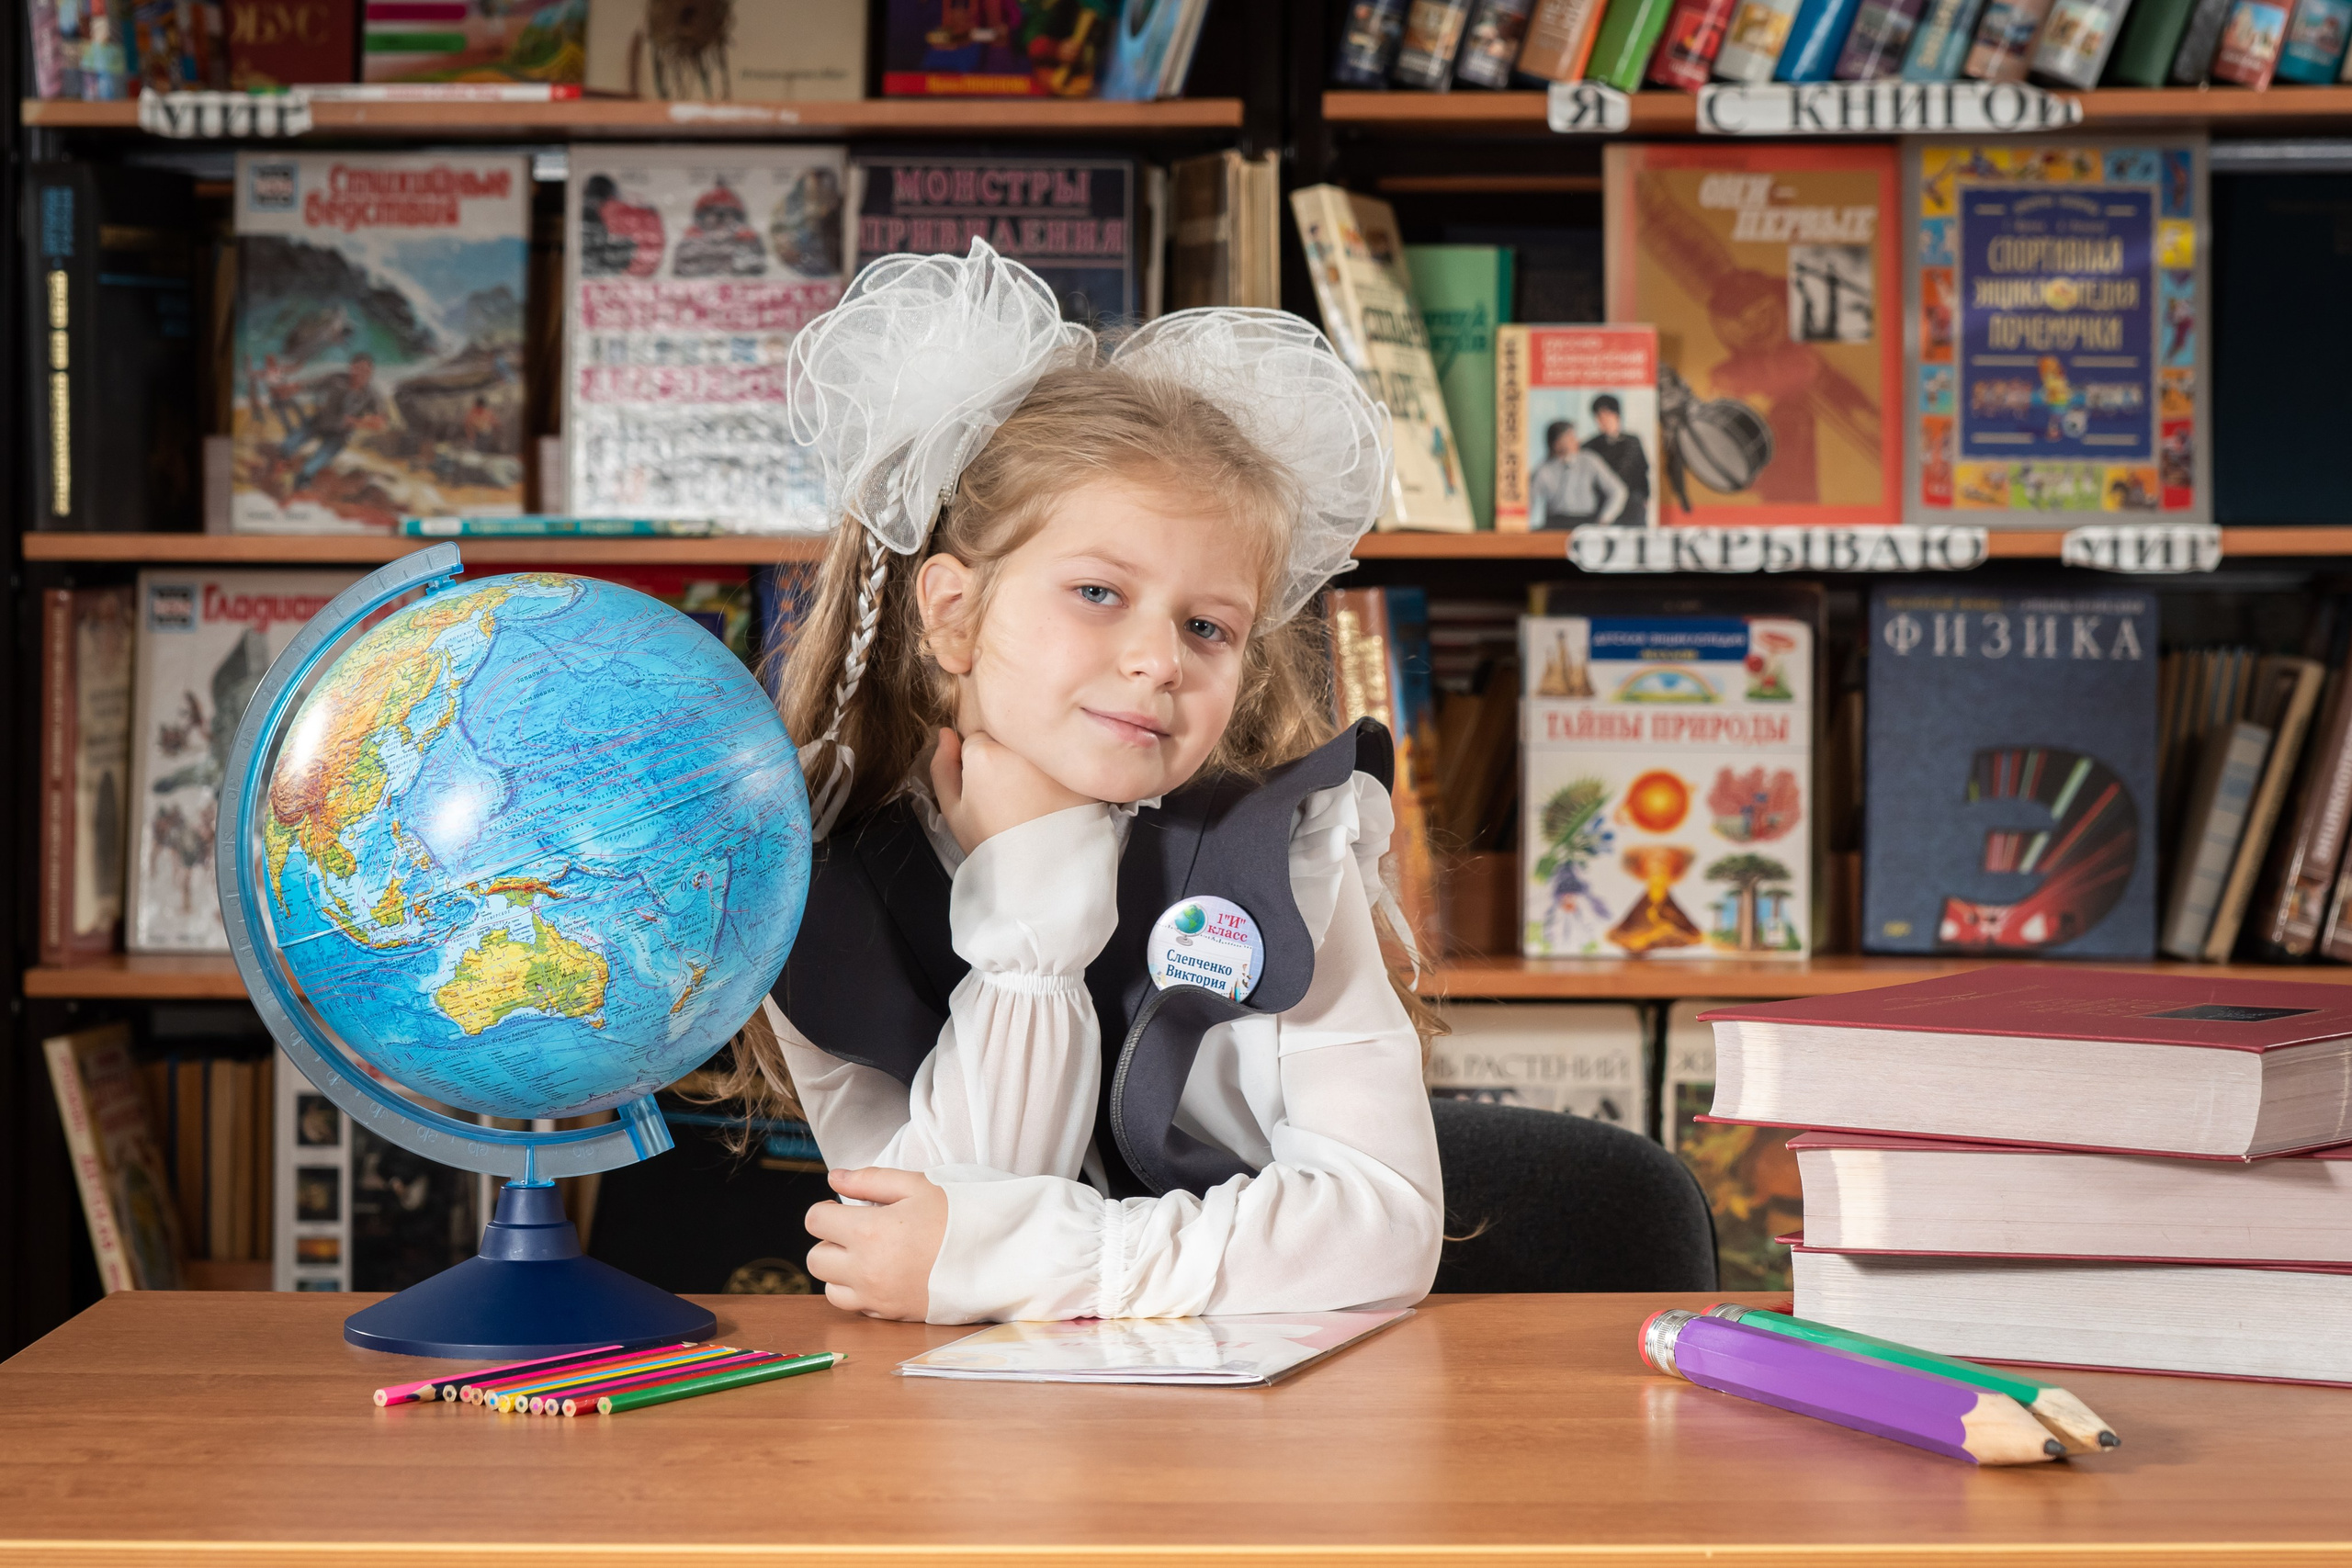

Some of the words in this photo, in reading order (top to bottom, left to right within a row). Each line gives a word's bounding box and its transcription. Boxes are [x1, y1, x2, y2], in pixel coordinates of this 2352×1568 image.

[1570, 87, 1606, 125] Я
[1706, 89, 1747, 130] С
[893, 168, 1091, 206] МОНСТРЫ
[859, 216, 1124, 254] ПРИВИДЕНИЯ
[1733, 208, 1877, 242] ПЕРВЫЕ
[1986, 235, 2125, 275] СПОРТИВНАЯ
[1572, 529, 1983, 570] ОТКРЫВАЮ
[1884, 611, 2143, 661] ФИЗИКА
[1546, 706, 1643, 741] ТАЙНЫ
[1651, 711, 1791, 744] ПРИРОДЫ
[1206, 924, 1249, 942] класс
[1165, 964, 1227, 990] Виктория
[1166, 948, 1233, 976] Слепченко
[1463, 1048, 1631, 1081] РАСТЕНИЙ
